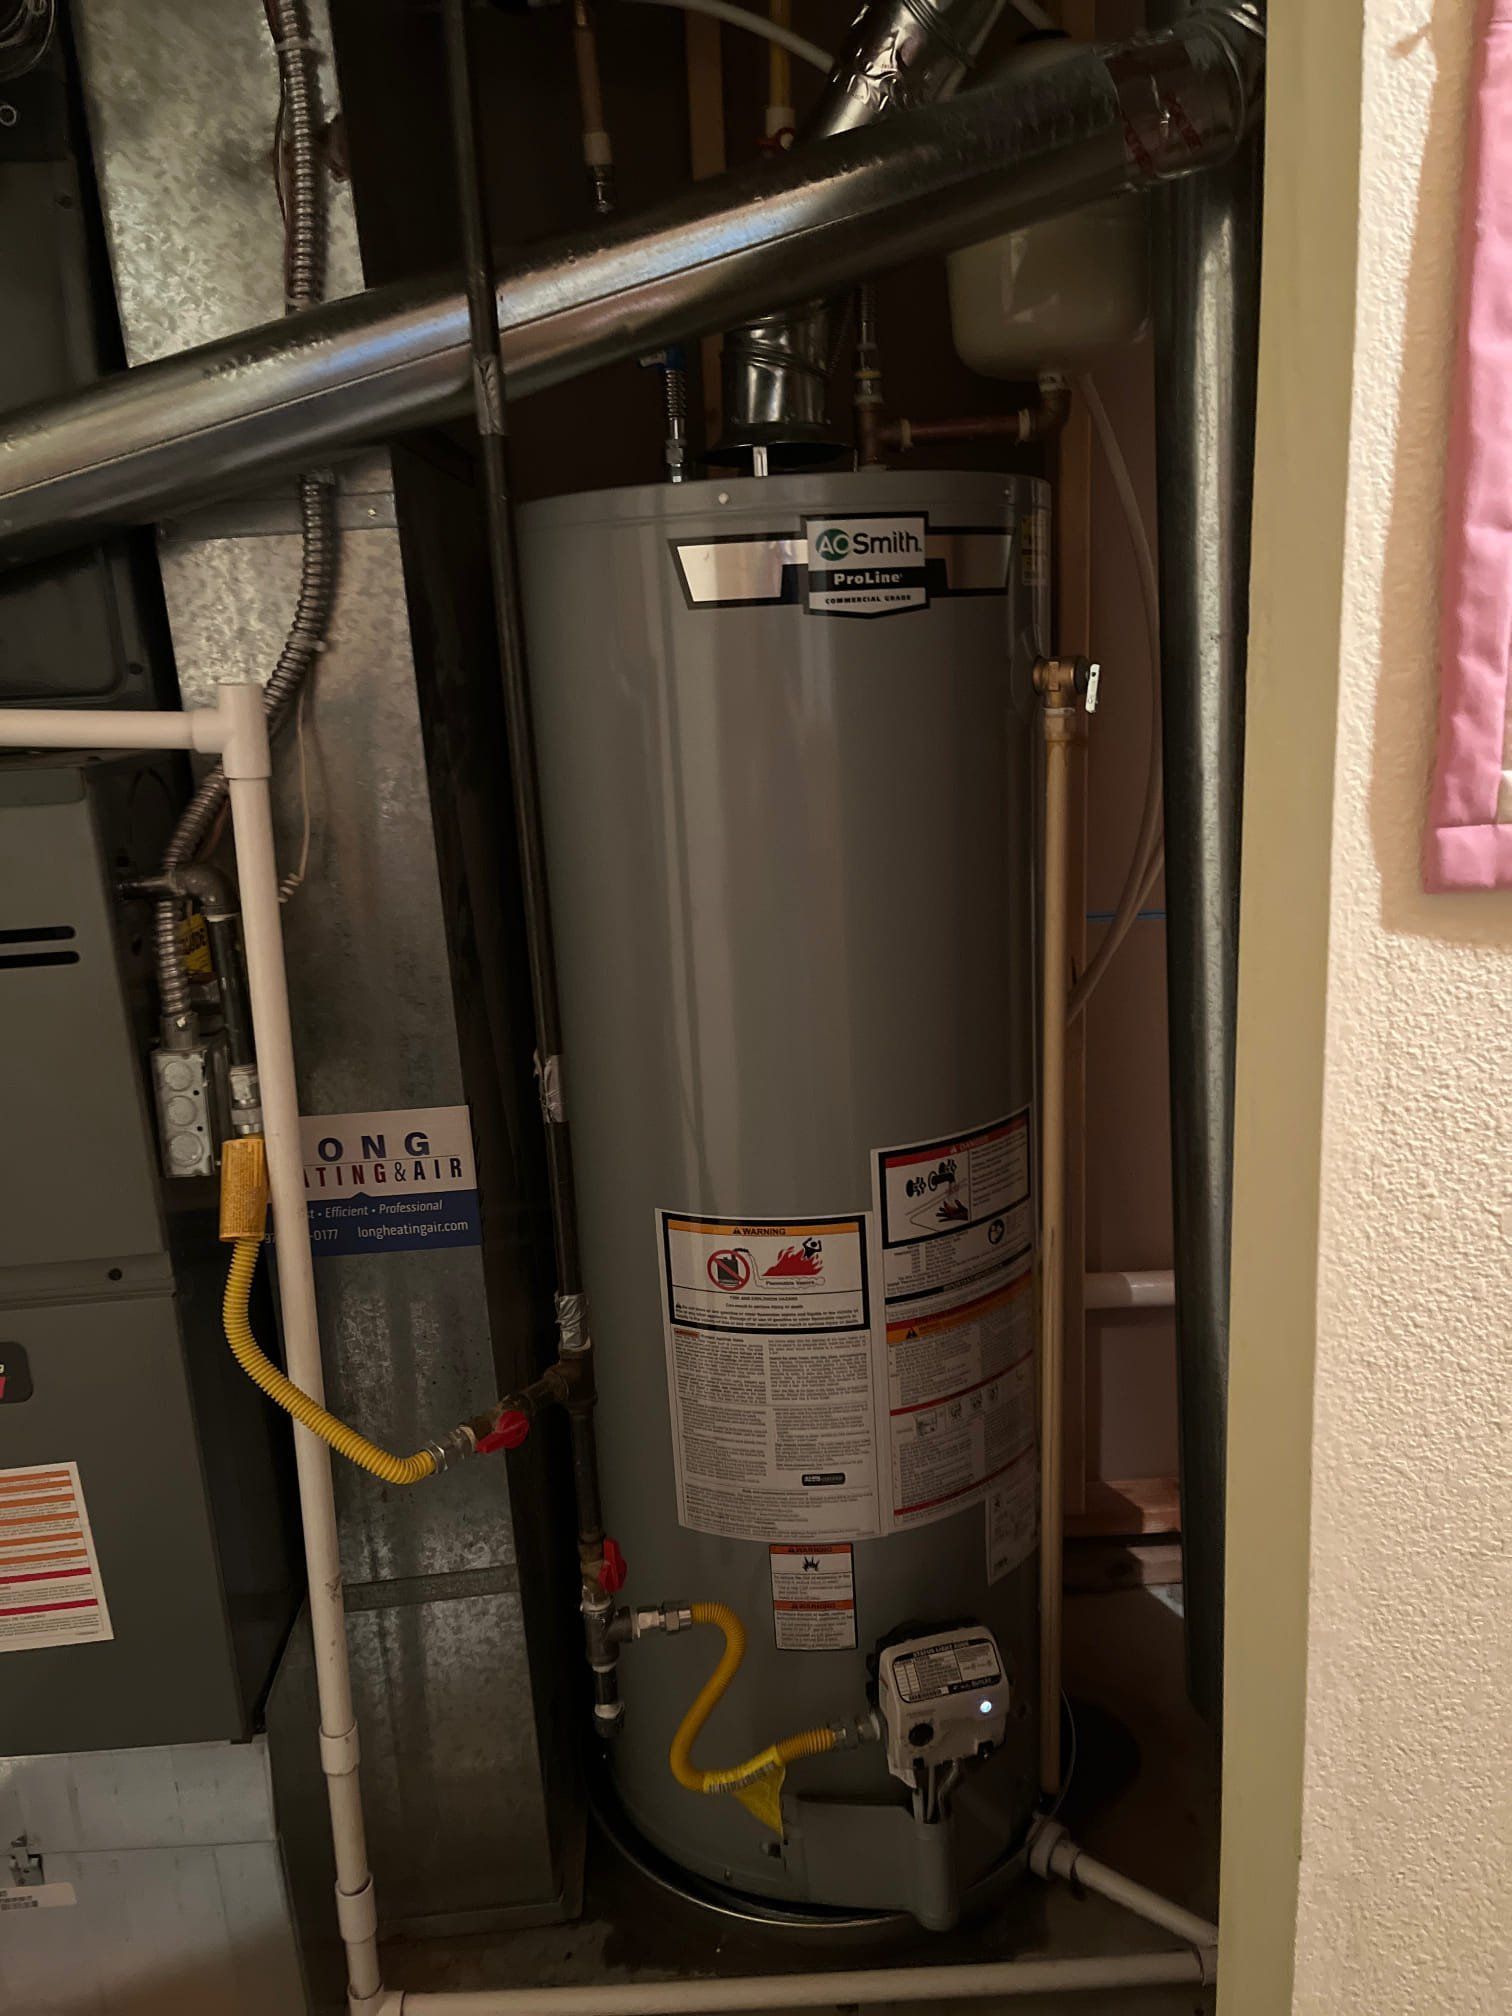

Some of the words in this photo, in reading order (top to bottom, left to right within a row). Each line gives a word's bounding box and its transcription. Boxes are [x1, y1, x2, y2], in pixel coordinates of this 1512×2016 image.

[853, 531, 919, 554] Smith
[834, 571, 900, 585] ProLine
[825, 596, 881, 605] COMMERCIAL
[884, 594, 912, 602] GRADE
[325, 1205, 369, 1219] Efficient
[379, 1200, 443, 1215] Professional
[357, 1221, 469, 1239] longheatingair.com
[742, 1227, 786, 1236] WARNING
